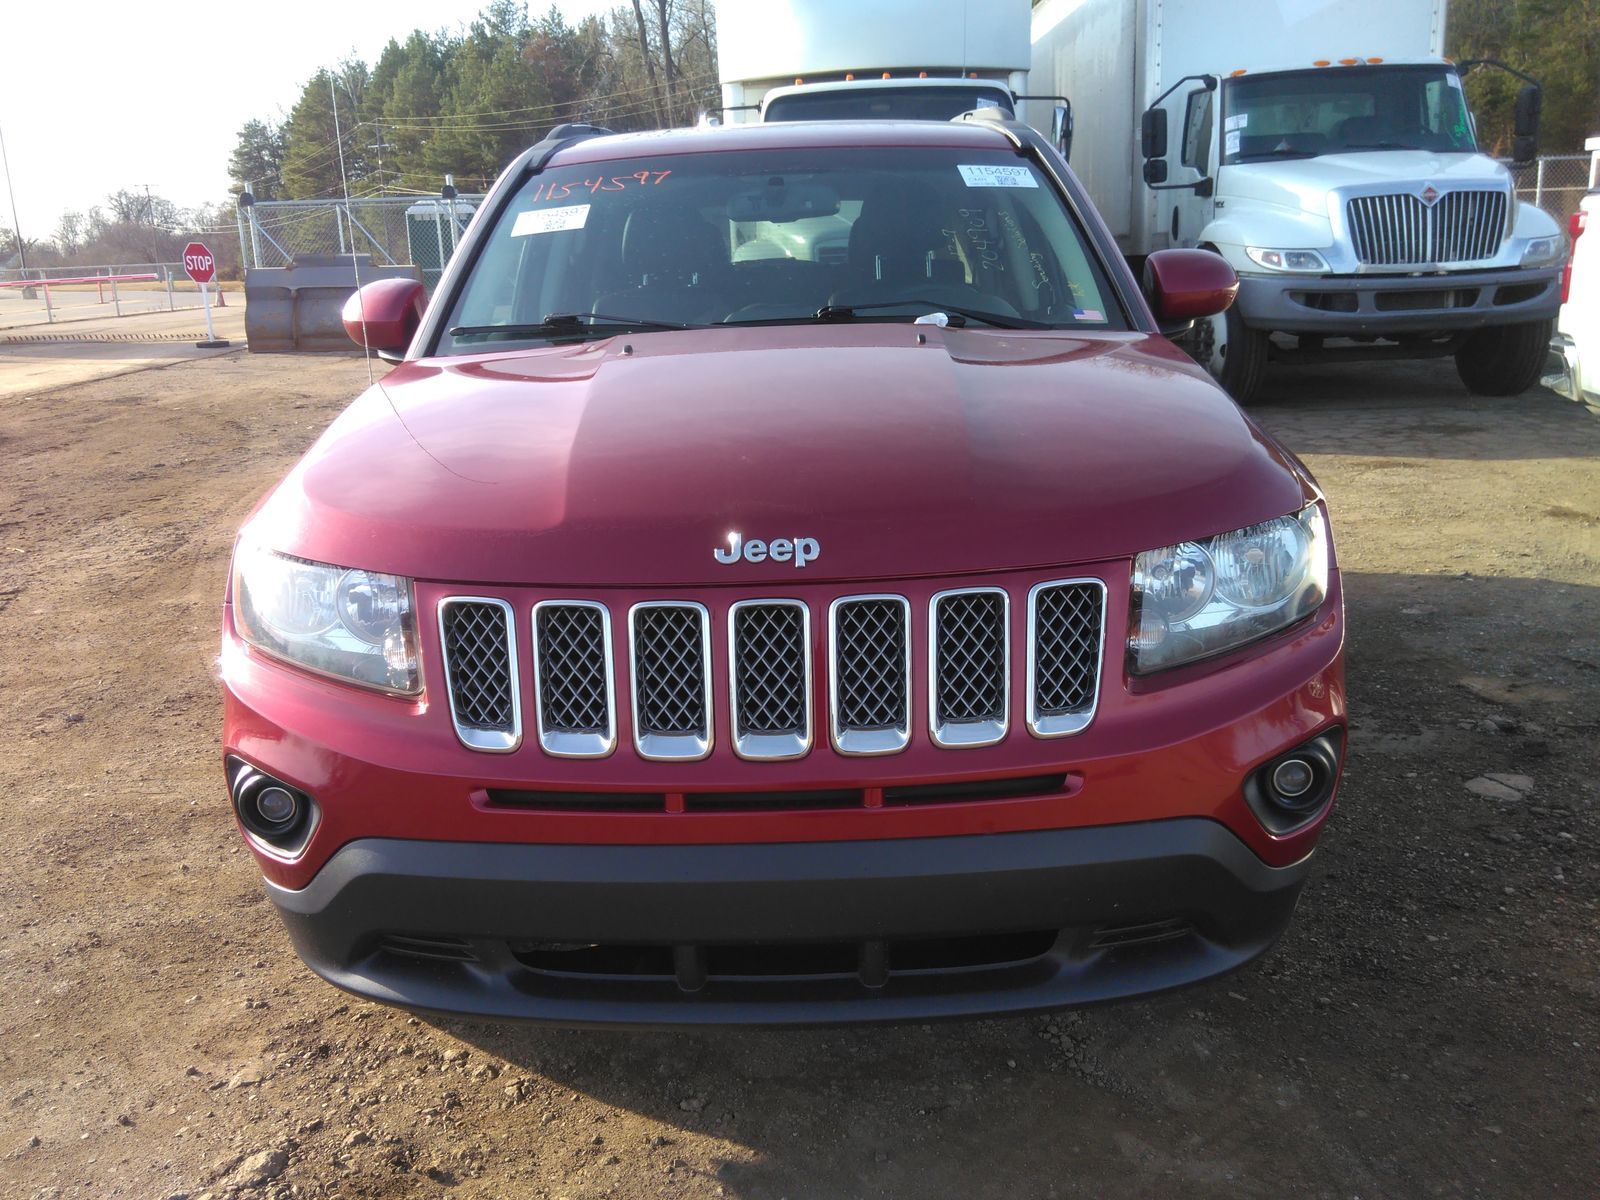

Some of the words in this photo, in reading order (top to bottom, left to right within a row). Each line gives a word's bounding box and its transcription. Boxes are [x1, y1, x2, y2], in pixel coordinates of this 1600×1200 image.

[967, 166, 1028, 177] 1154597
[533, 170, 673, 202] 1154597
[526, 206, 589, 221] 54597
[186, 255, 212, 271] STOP
[713, 531, 821, 568] Jeep
